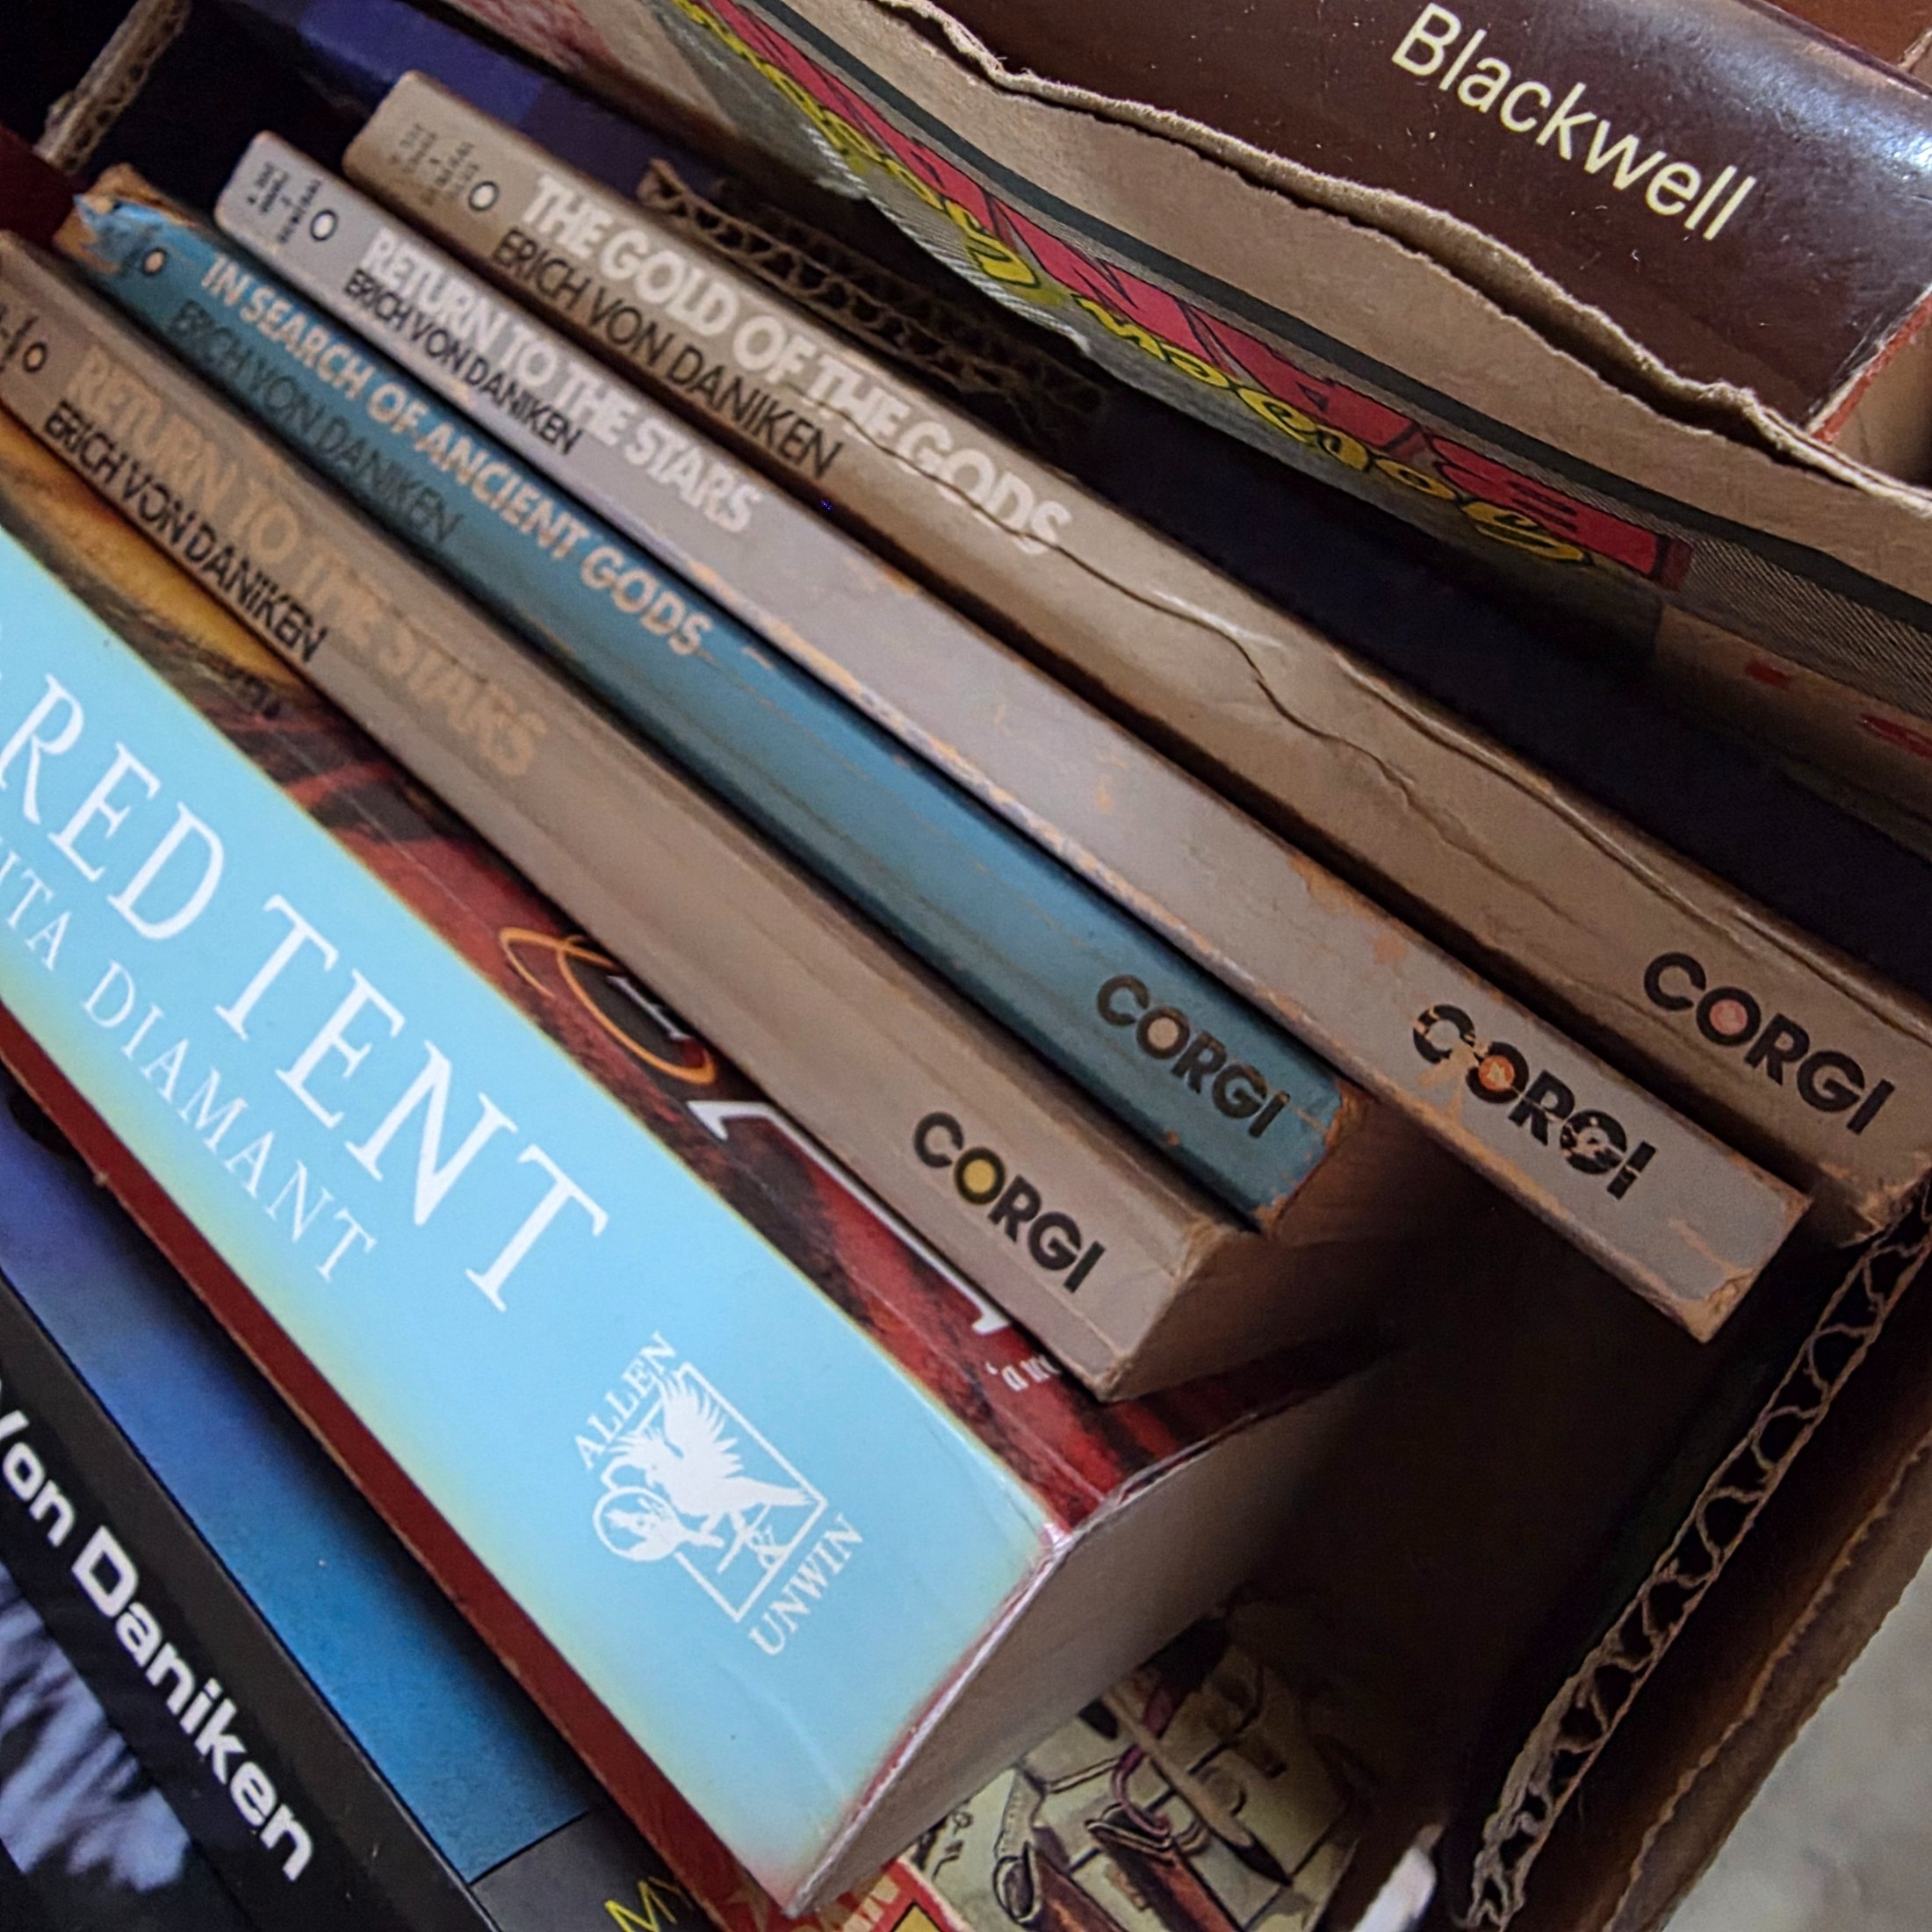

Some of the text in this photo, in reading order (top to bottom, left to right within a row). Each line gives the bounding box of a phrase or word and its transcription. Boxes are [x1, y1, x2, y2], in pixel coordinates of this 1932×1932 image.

[1391, 2, 1756, 241] Blackwell
[173, 298, 465, 544] ERICH VON DANIKEN
[201, 255, 712, 656] IN SEARCH OF ANCIENT GODS
[343, 269, 583, 456] ERICH VON DANIKEN
[361, 227, 761, 532] RETURN TO THE STARS
[494, 228, 844, 479] ERICH VON DANIKEN
[524, 175, 1072, 555] THE GOLD OF THE GODS
[1071, 292, 1592, 566] Golden
[45, 399, 328, 663] ERICH VON DANIKEN
[66, 343, 547, 775] RETURN TO THE STARS
[0, 673, 609, 1314] RED TENT
[1096, 974, 1291, 1139] CORGI
[1411, 1004, 1656, 1200] CORGI
[1643, 951, 1896, 1136] CORGI
[82, 960, 378, 1283] DIAMANT
[912, 1112, 1106, 1294] CORGI
[574, 1330, 676, 1470] ALLEN
[71, 1525, 314, 1882] Daniken
[748, 1511, 864, 1656] UNWIN
